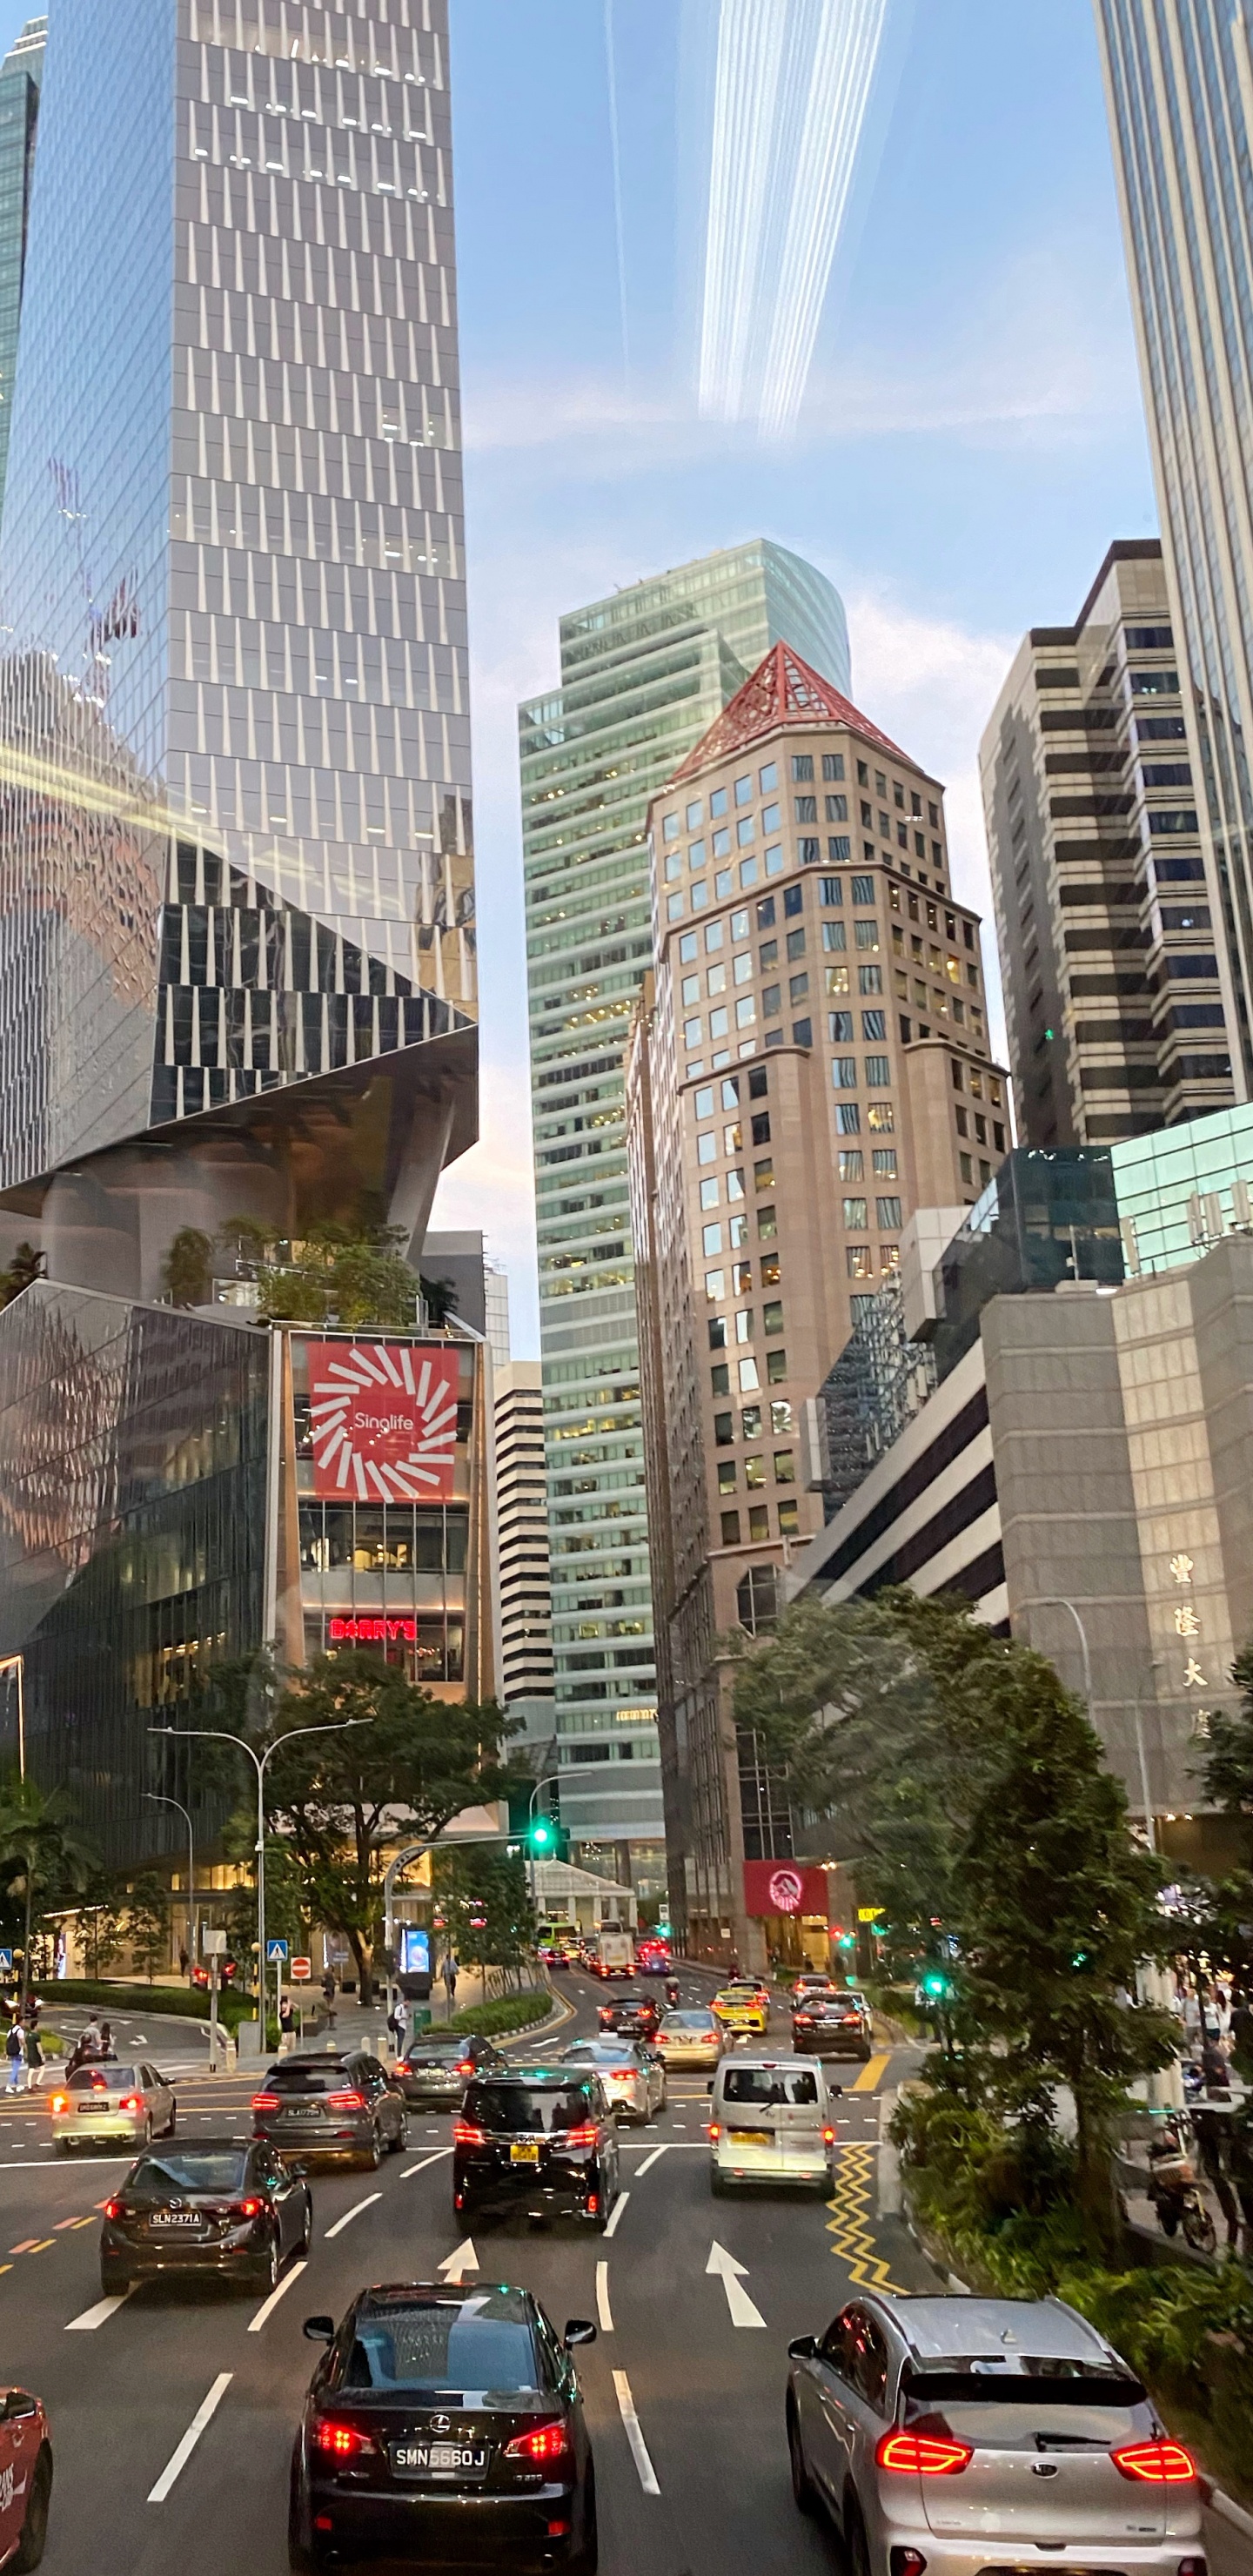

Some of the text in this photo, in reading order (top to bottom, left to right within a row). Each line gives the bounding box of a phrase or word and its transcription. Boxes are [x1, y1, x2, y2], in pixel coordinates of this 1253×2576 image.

[354, 1412, 413, 1434] Singlife
[152, 2213, 199, 2224] SLN2371A
[396, 2449, 485, 2466] SMN5660J
